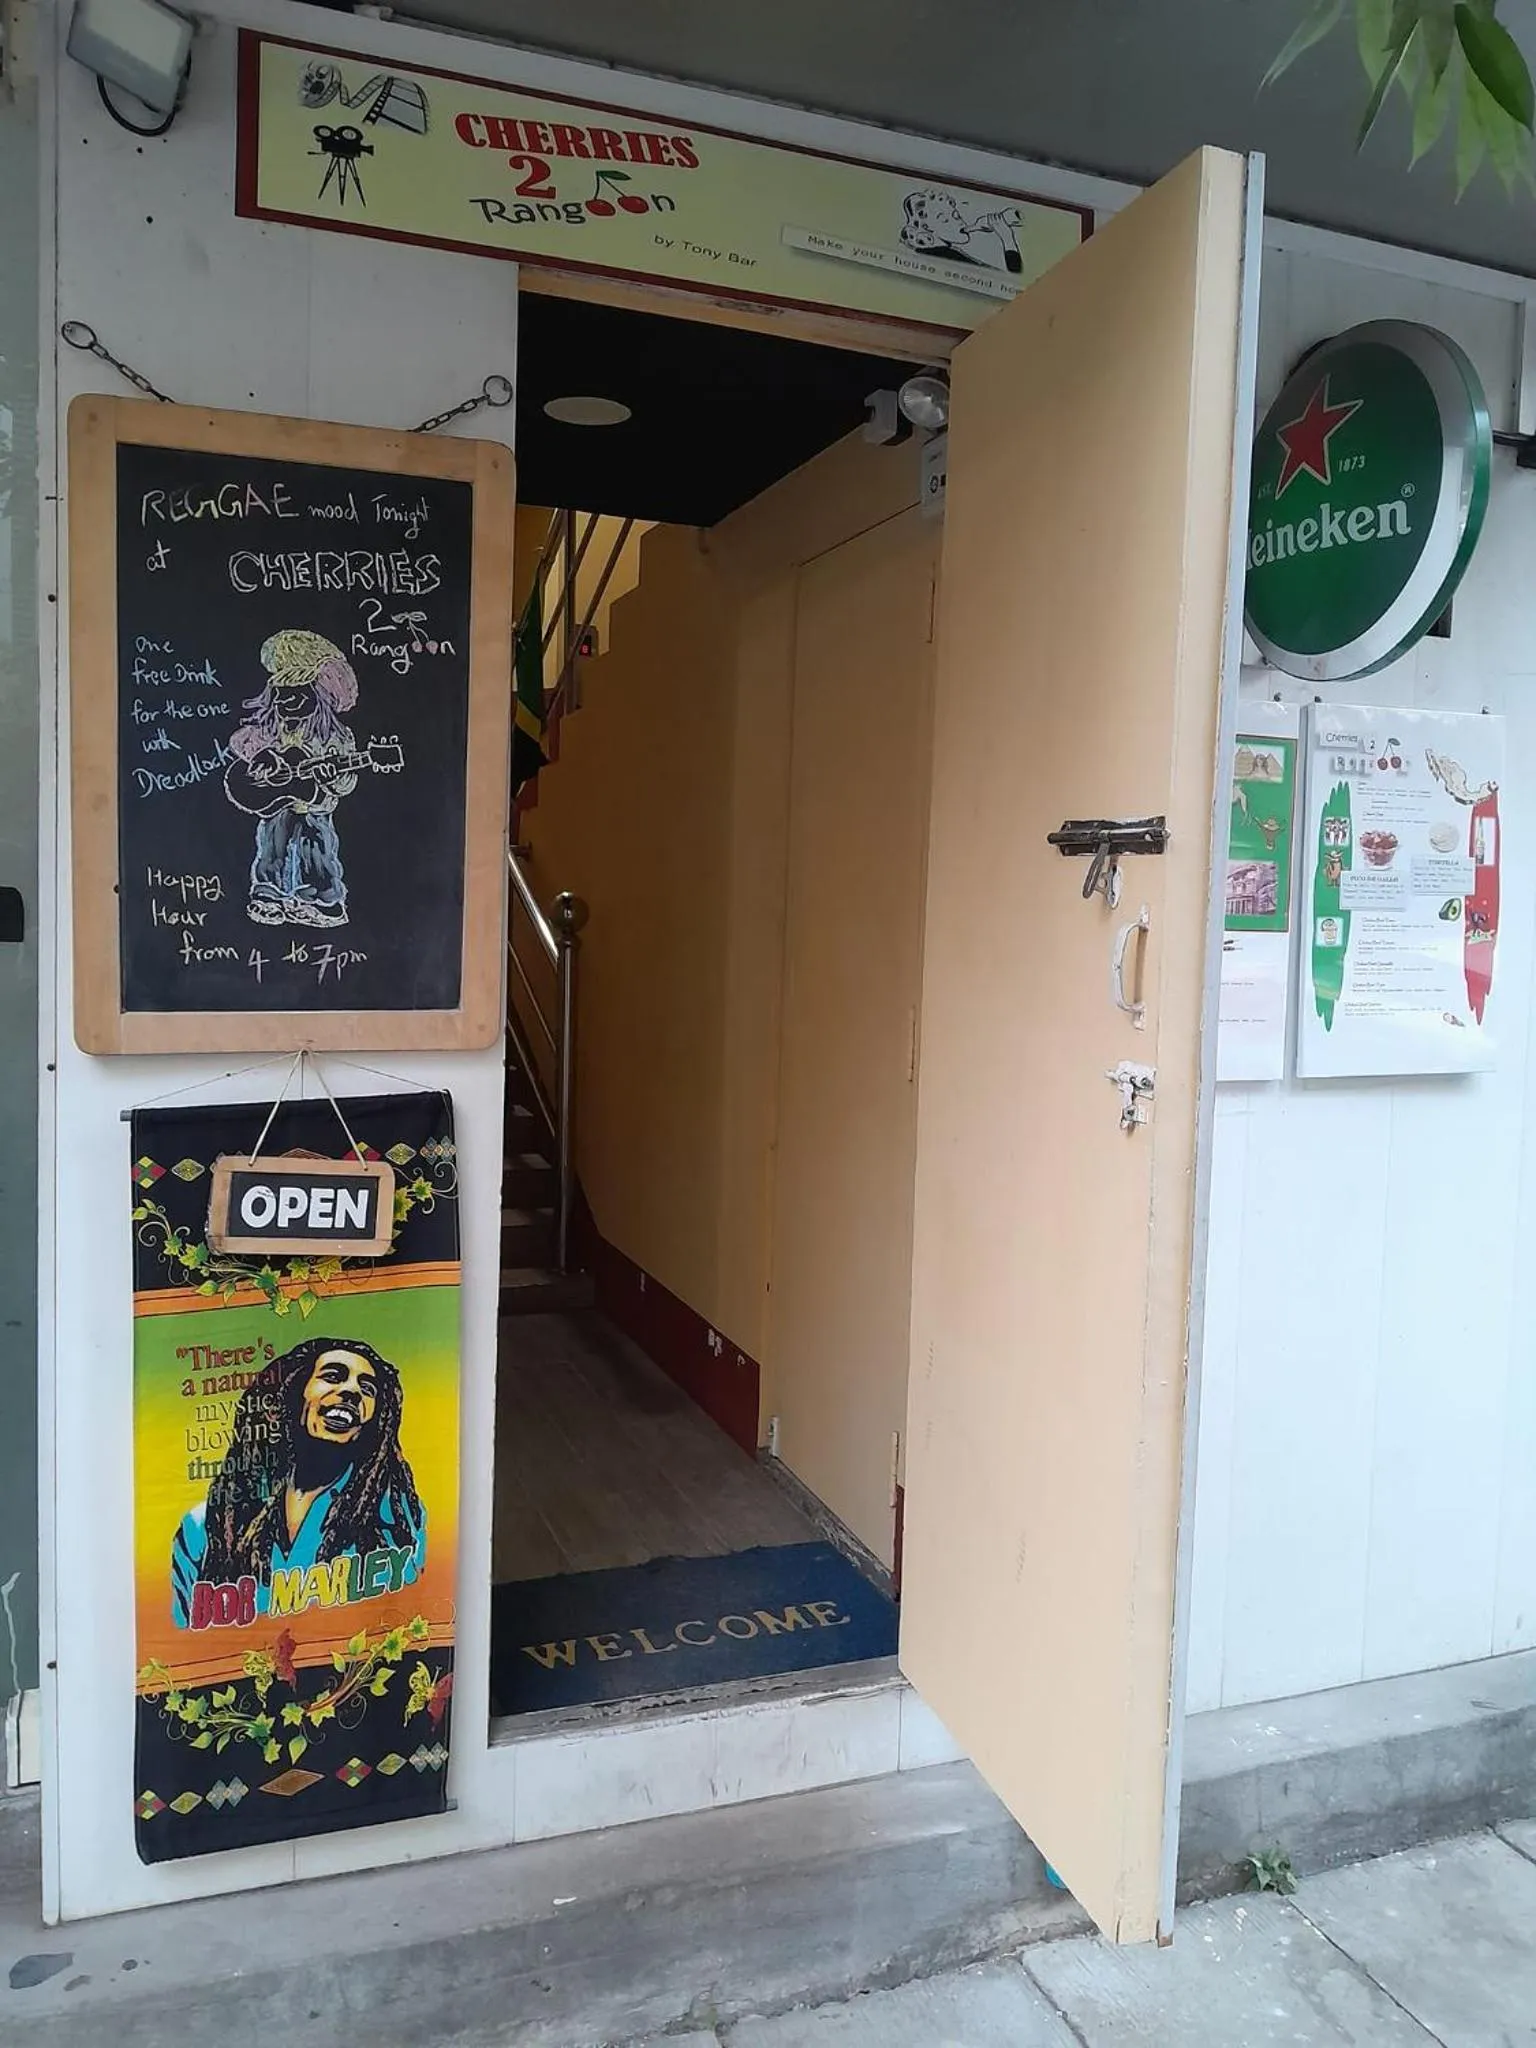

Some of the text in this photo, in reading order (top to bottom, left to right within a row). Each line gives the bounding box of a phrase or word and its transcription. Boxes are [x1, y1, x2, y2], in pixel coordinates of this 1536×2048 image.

[454, 112, 700, 169] CHERRIES
[508, 156, 557, 200] 2
[653, 234, 758, 268] by Tony Bar
[807, 234, 844, 250] Make
[852, 246, 885, 261] your
[894, 255, 936, 274] house
[944, 270, 994, 289] second
[1338, 455, 1366, 473] 1873
[141, 483, 432, 539] REGGAE mood Tonight
[144, 540, 442, 596] at CHERRIES
[358, 597, 398, 634] 2
[135, 637, 175, 655] One
[175, 660, 223, 688] Drink
[131, 699, 231, 725] for the one
[142, 727, 182, 753] with
[147, 867, 226, 901] Happy
[151, 898, 209, 928] Hour
[179, 932, 240, 962] from
[247, 948, 271, 984] 4
[281, 939, 310, 964] to
[240, 1184, 370, 1229] OPEN
[181, 1360, 283, 1397] a natural
[195, 1392, 275, 1426] mystic
[185, 1419, 283, 1453] blowing
[187, 1444, 280, 1481] through
[190, 1544, 419, 1631] BOB MARLEY
[520, 1600, 852, 1670] WELCOME
